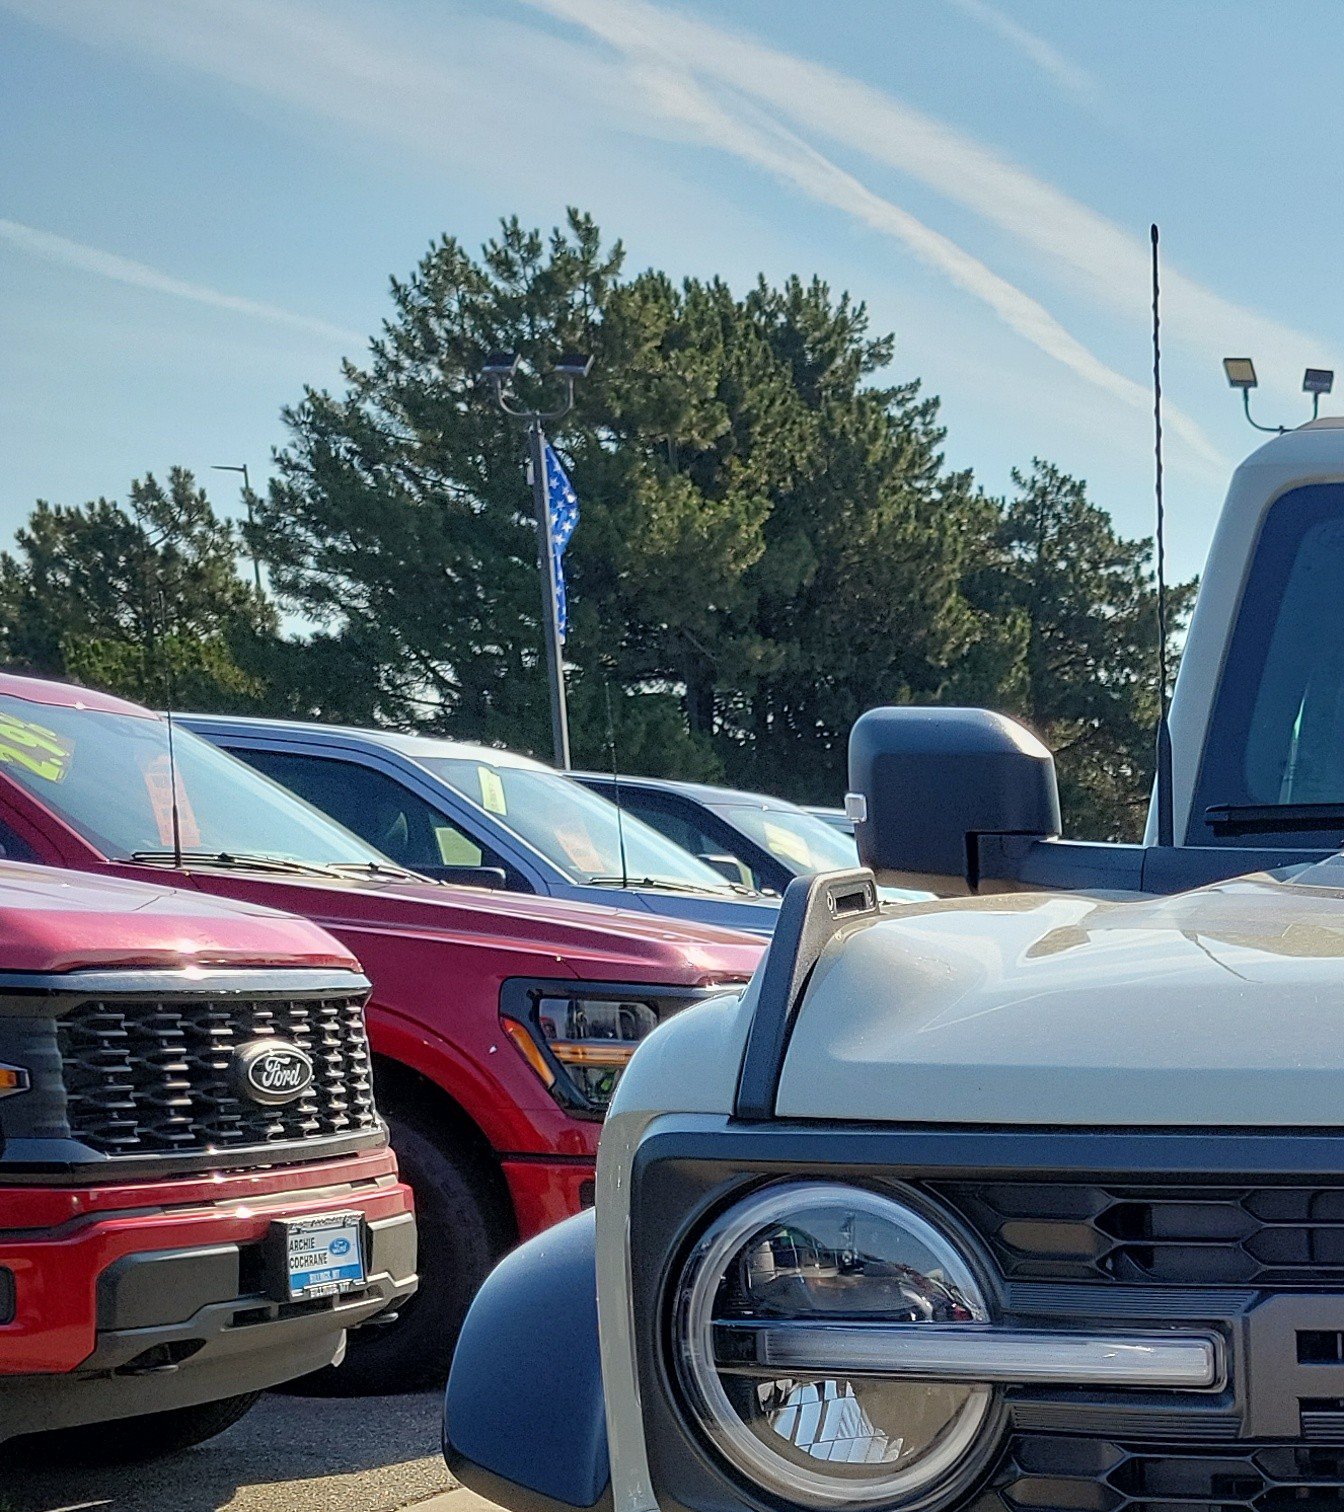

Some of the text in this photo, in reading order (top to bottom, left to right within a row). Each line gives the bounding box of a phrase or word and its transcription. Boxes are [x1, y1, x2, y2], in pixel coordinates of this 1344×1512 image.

[262, 1056, 301, 1087] Ford
[290, 1237, 316, 1252] ARCHIE
[289, 1252, 328, 1270] COCHRANE
